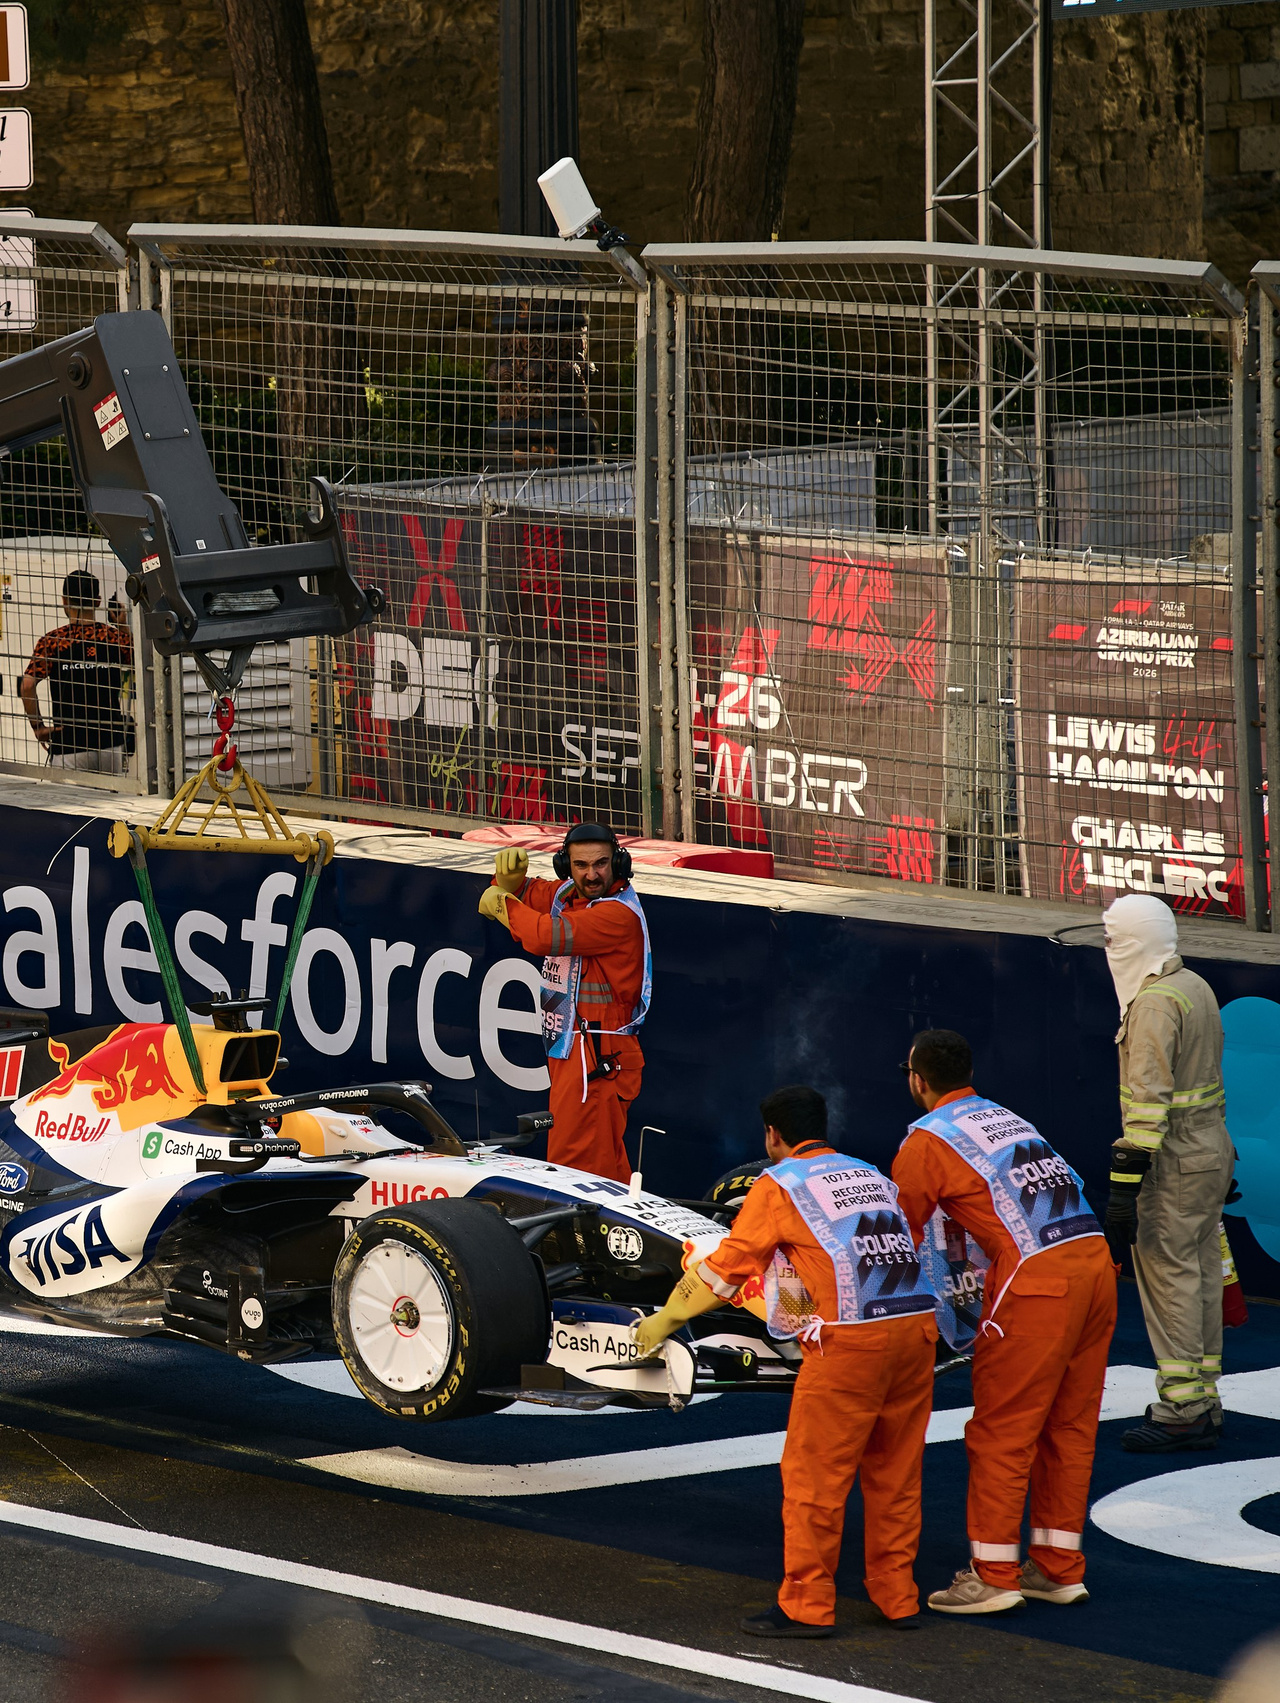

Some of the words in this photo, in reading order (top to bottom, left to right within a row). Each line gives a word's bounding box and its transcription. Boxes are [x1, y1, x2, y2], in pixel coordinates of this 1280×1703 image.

[1096, 628, 1199, 650] AZERBAIJAN
[1133, 668, 1157, 678] 2026
[1048, 714, 1156, 755] LEWIS
[1049, 752, 1224, 803] HAMILTON
[1071, 815, 1226, 865] CHARLES
[1083, 851, 1230, 903] LECLERC
[35, 1110, 69, 1138] Red
[70, 1113, 110, 1142] Bull
[164, 1140, 194, 1157] Cash
[197, 1144, 222, 1160] App
[264, 1143, 300, 1153] hahnair
[729, 1175, 757, 1190] ZE
[823, 1169, 875, 1184] 1073-AZE
[1008, 1156, 1069, 1188] COURS
[831, 1183, 883, 1199] RECOVERY
[18, 1204, 131, 1286] VISA
[851, 1232, 912, 1257] COURS
[556, 1330, 599, 1353] Cash
[605, 1337, 639, 1360] App
